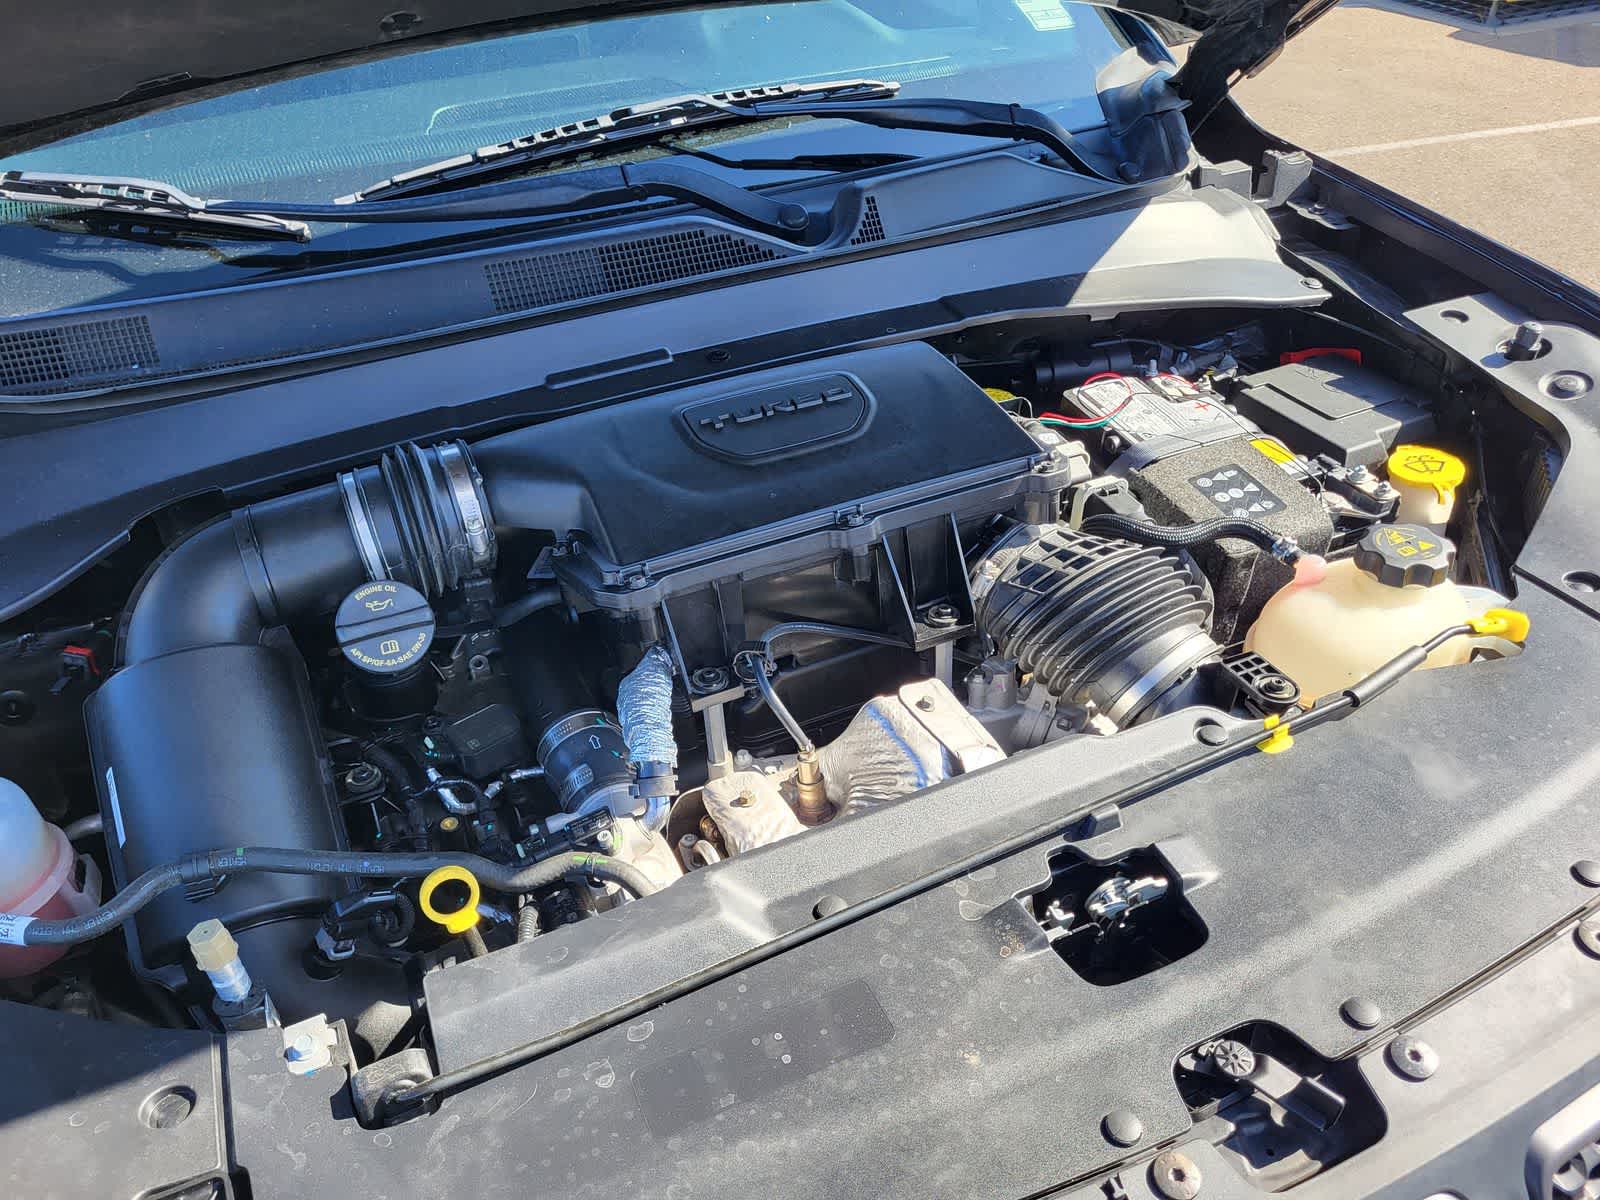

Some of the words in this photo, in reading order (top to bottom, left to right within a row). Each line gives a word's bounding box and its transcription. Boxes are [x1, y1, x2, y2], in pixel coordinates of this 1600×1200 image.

[700, 387, 853, 430] TURBO
[354, 584, 383, 601] ENGINE
[384, 584, 398, 593] OIL
[350, 648, 363, 659] API
[217, 855, 248, 868] HEATER
[82, 907, 118, 931] HEATER
